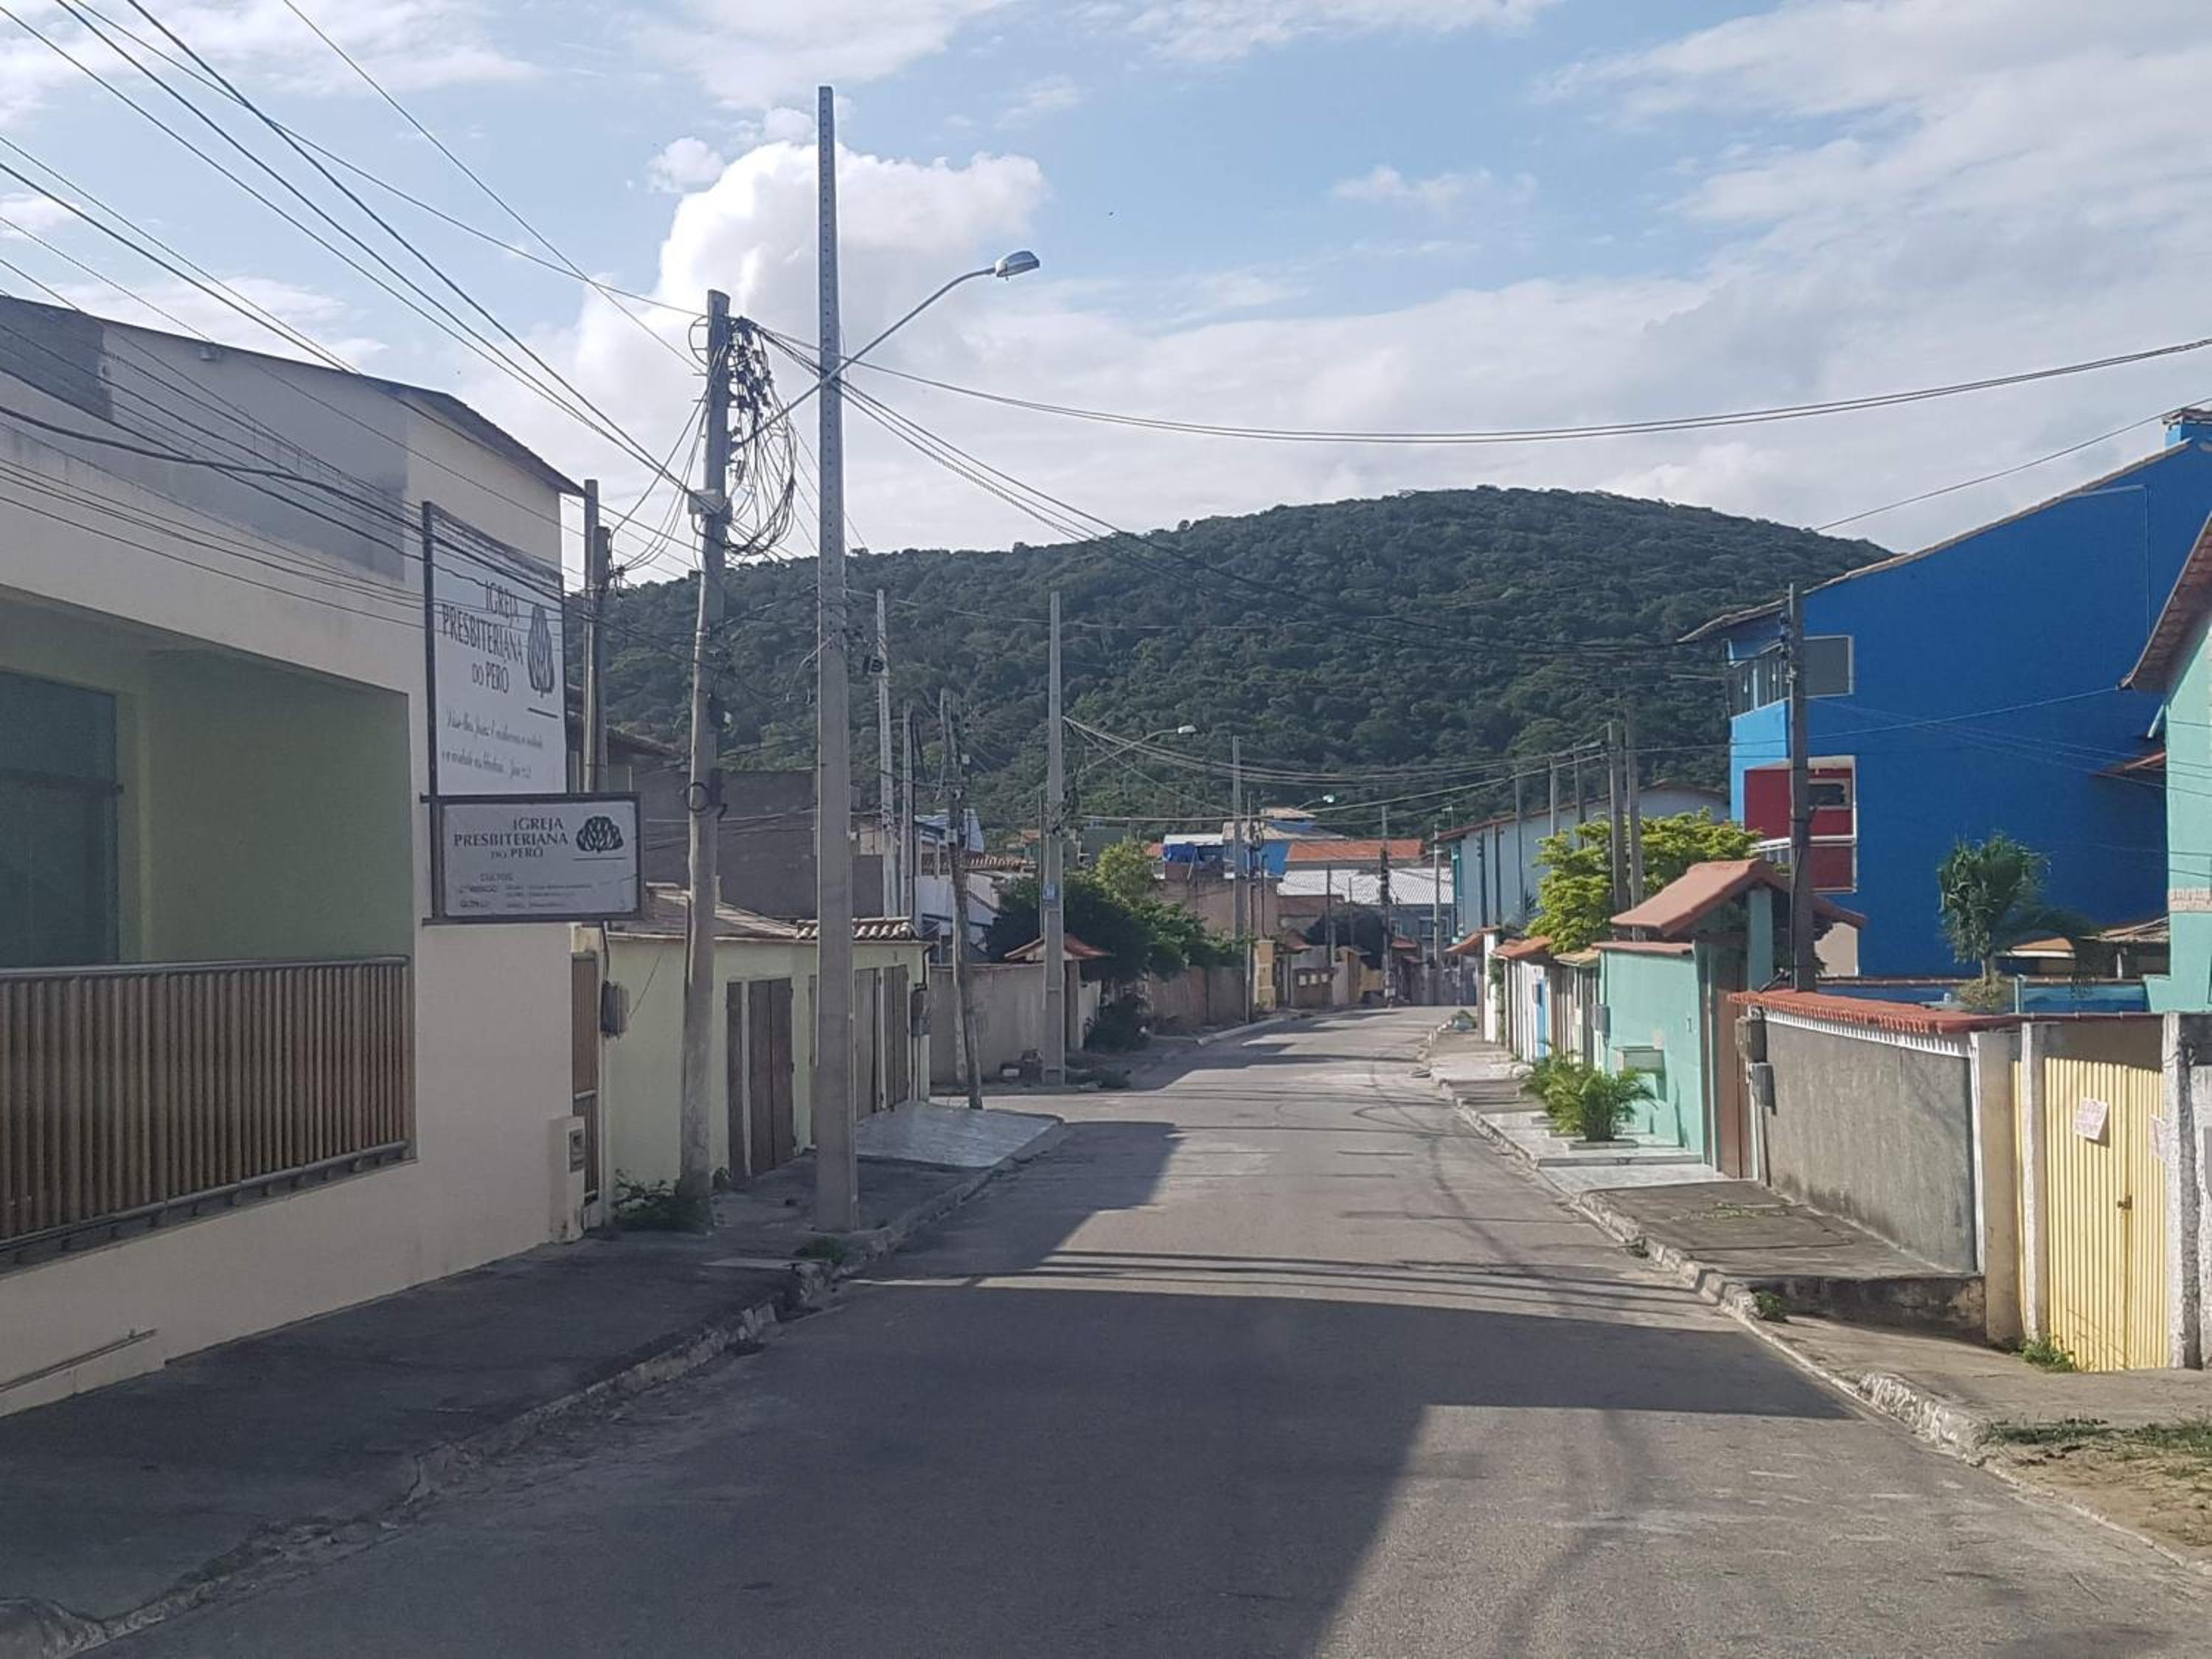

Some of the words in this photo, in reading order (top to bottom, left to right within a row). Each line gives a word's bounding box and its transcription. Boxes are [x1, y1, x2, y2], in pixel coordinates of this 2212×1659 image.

[486, 580, 519, 627] IGREJA
[442, 603, 524, 665] PRESBITERIANA
[453, 832, 568, 846] PRESBITERIANA
[512, 817, 564, 832] IGREJA
